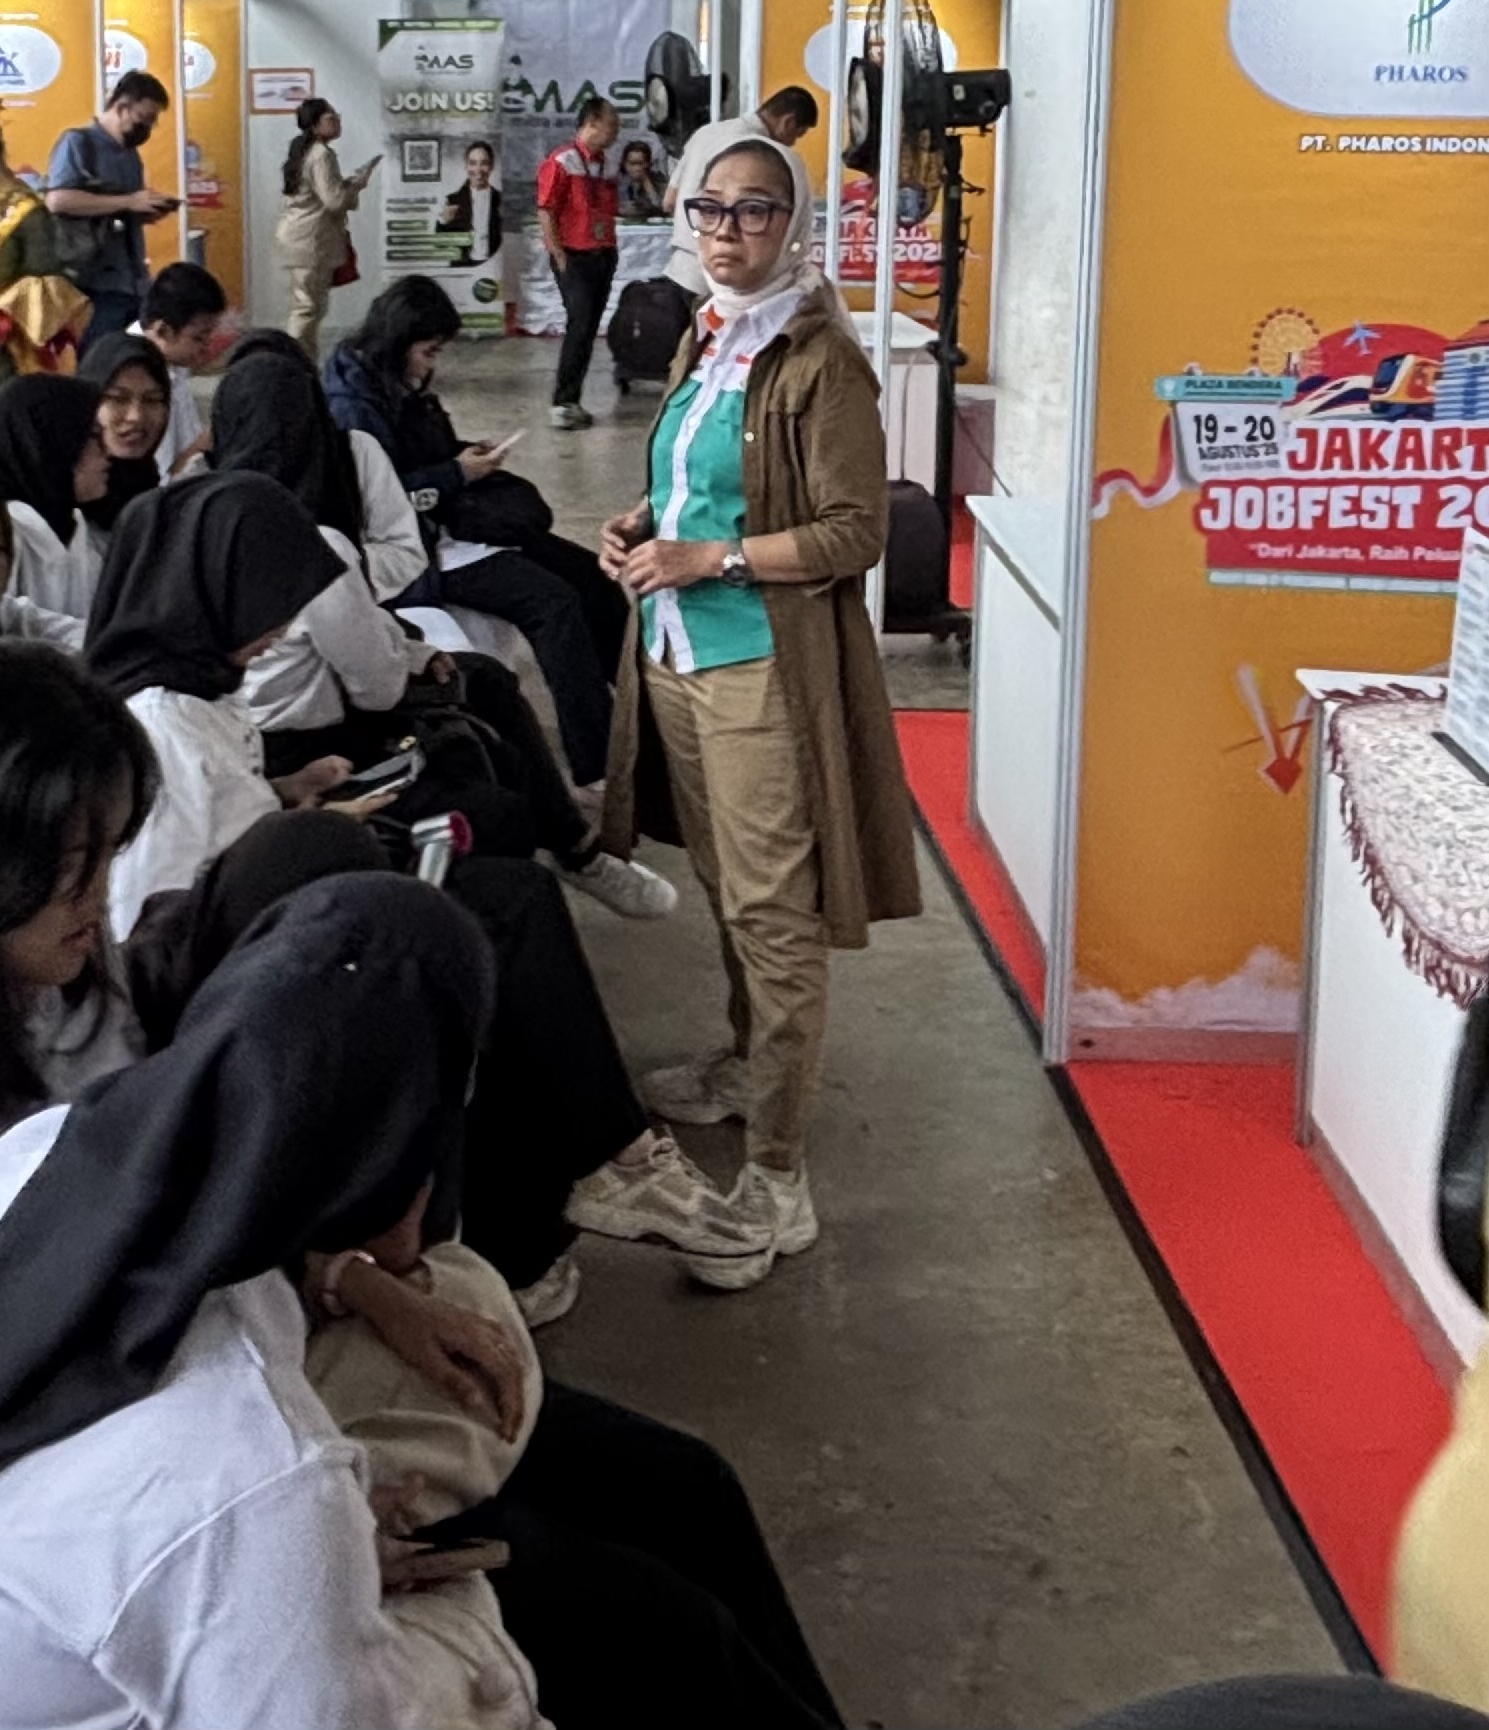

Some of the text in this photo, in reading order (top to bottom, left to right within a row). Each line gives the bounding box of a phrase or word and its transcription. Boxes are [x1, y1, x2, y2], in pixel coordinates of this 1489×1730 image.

[1374, 65, 1469, 84] PHAROS
[390, 92, 495, 112] JOIN US!
[1300, 136, 1332, 151] PT.
[1338, 136, 1422, 153] PHAROS
[893, 243, 942, 263] 202
[1192, 413, 1219, 444] 19
[1243, 415, 1275, 443] 20
[1198, 444, 1260, 461] AGUSTUS
[1201, 486, 1420, 529] JOBFEST
